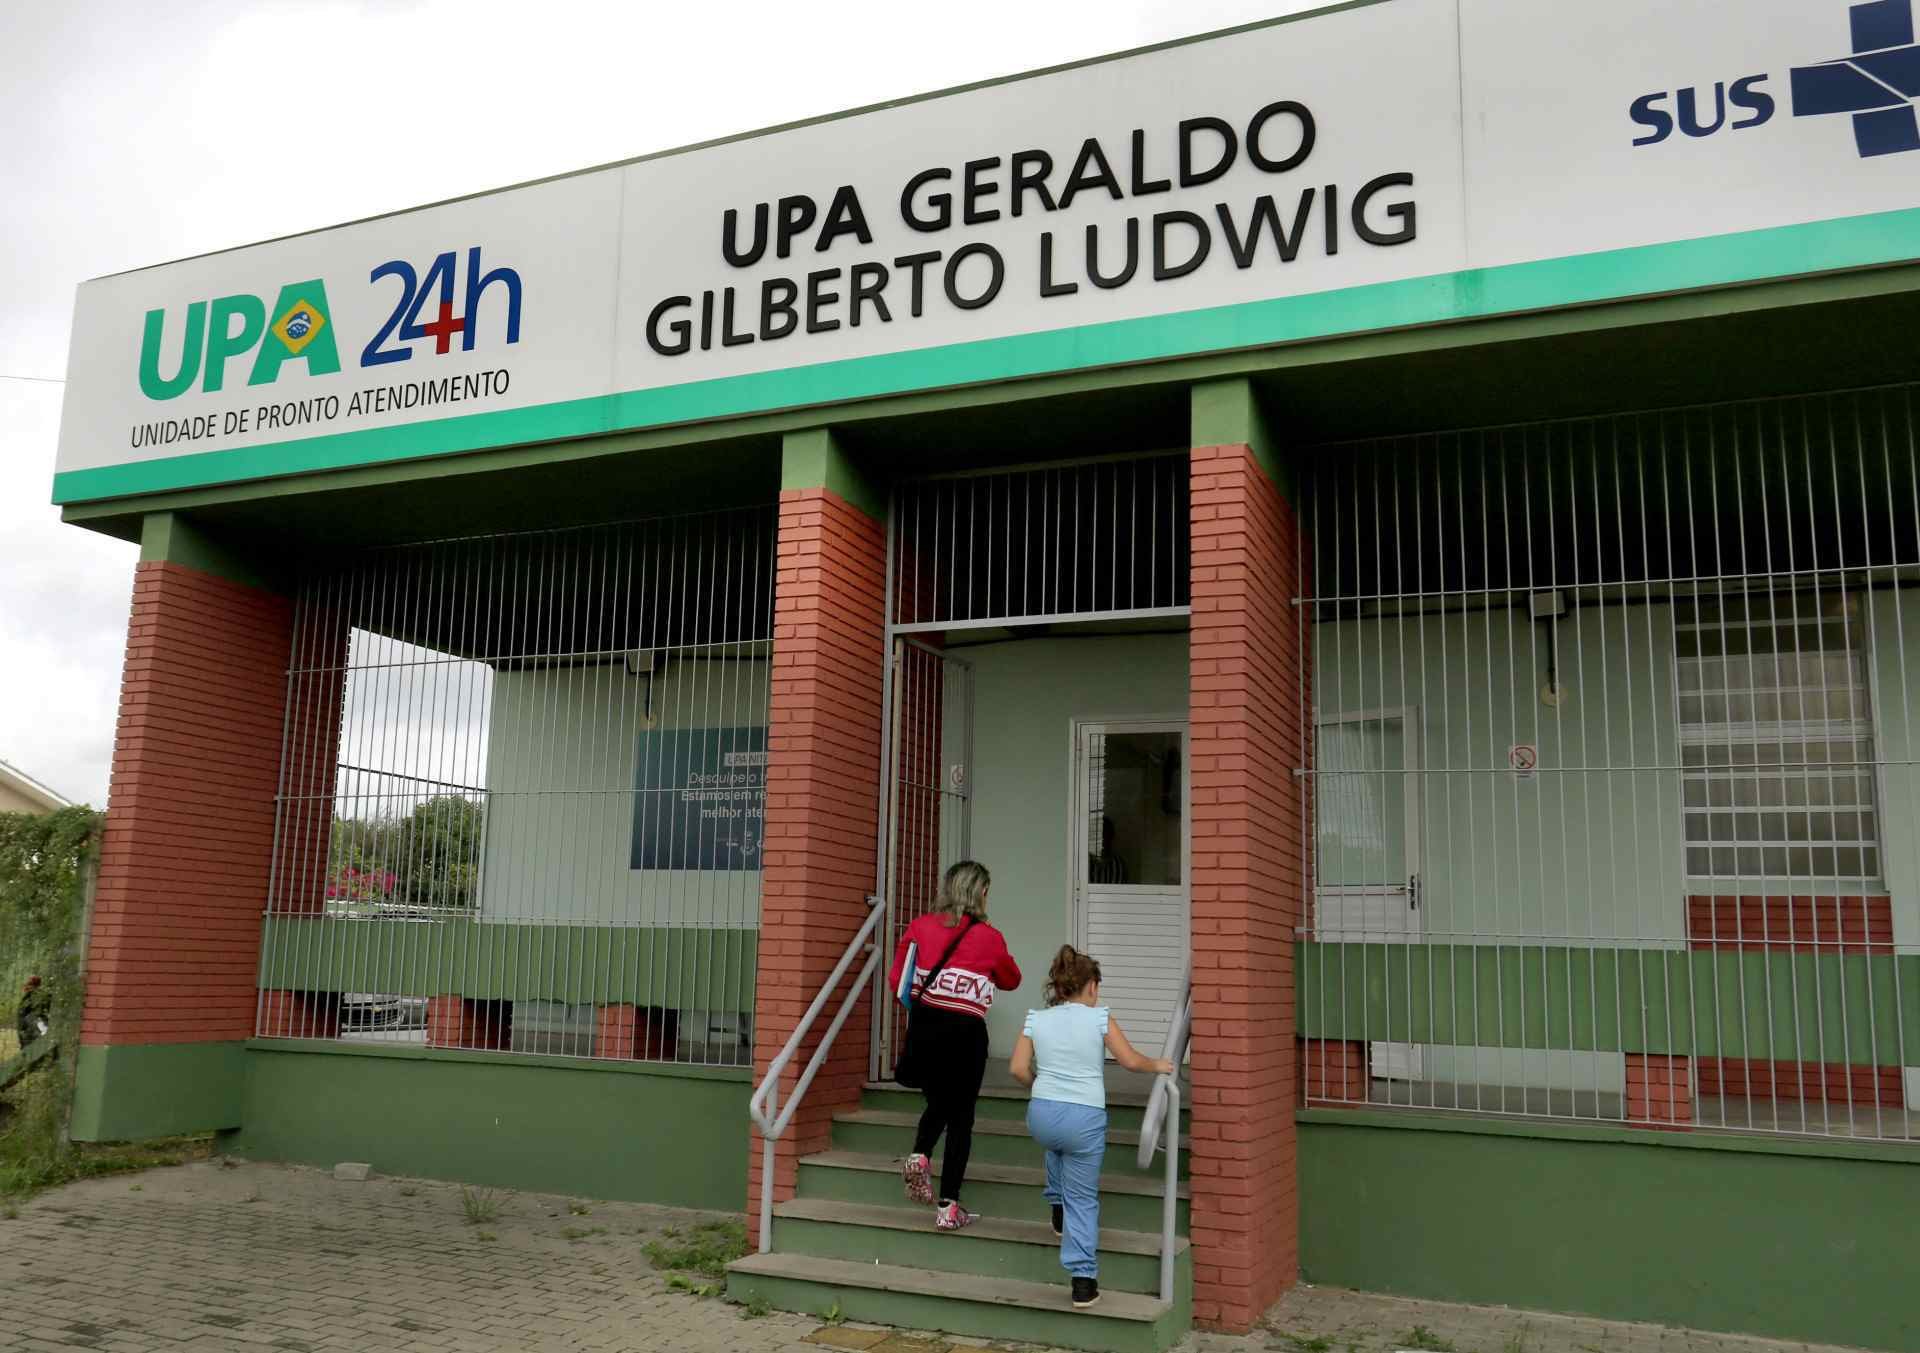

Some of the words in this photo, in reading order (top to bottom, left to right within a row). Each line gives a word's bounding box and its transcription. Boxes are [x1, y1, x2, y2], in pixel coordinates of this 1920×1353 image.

[1629, 73, 1775, 147] SUS
[722, 184, 874, 270] UPA
[899, 100, 1317, 234] GERALDO
[645, 242, 1006, 358] GILBERTO
[1039, 171, 1417, 299] LUDWIG
[138, 278, 341, 401] UPA
[360, 246, 523, 368] 24h
[131, 414, 217, 449] UNIDADE
[223, 408, 250, 436] DE
[256, 395, 340, 431] PRONTO
[346, 368, 511, 417] ATENDIMENTO
[681, 790, 731, 801] Estamos
[733, 791, 752, 801] em
[755, 791, 768, 801] re
[689, 771, 746, 786] Desculpe
[702, 806, 742, 818] melhor
